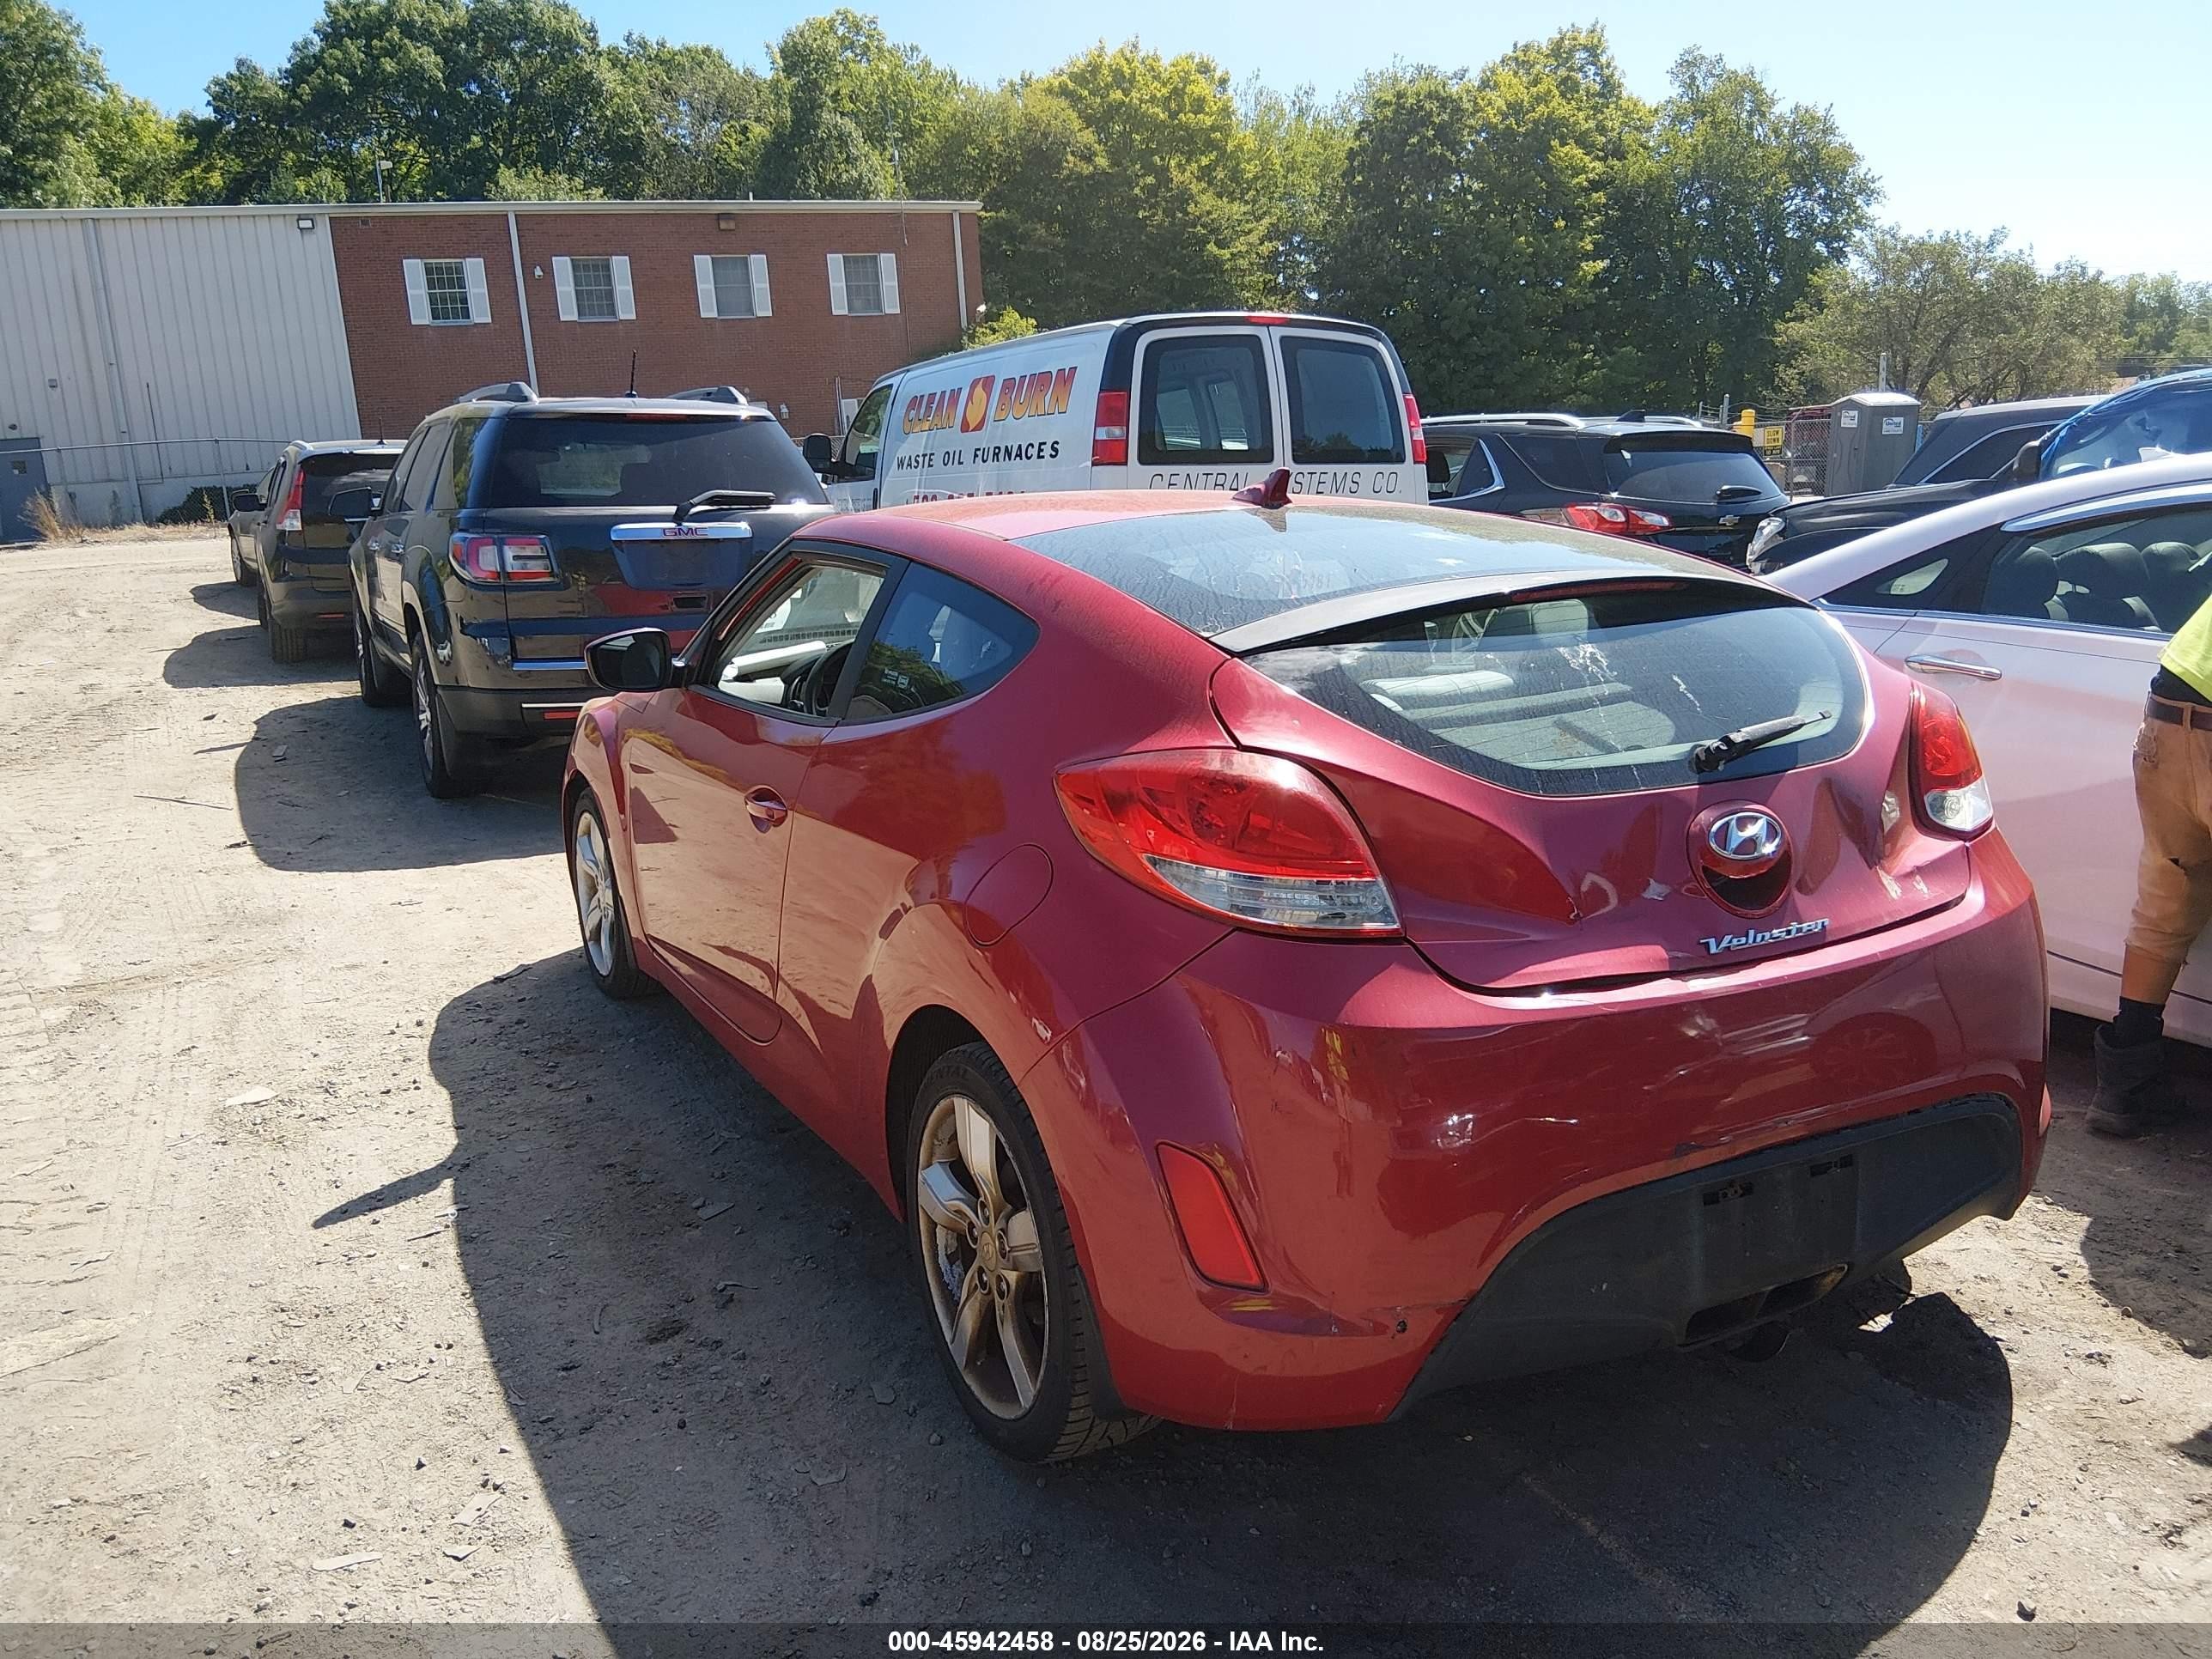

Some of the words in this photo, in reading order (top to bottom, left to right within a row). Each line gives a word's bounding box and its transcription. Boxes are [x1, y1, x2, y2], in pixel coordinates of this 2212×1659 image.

[902, 387, 963, 435] CLEAN
[994, 366, 1079, 422] BURN
[896, 453, 935, 471] WASTE
[942, 449, 964, 467] OIL
[972, 441, 1060, 465] FURNACES
[1269, 471, 1362, 495] STEMS
[1372, 471, 1402, 494] CO.
[662, 526, 709, 537] GMC
[1699, 918, 1832, 955] Veloster
